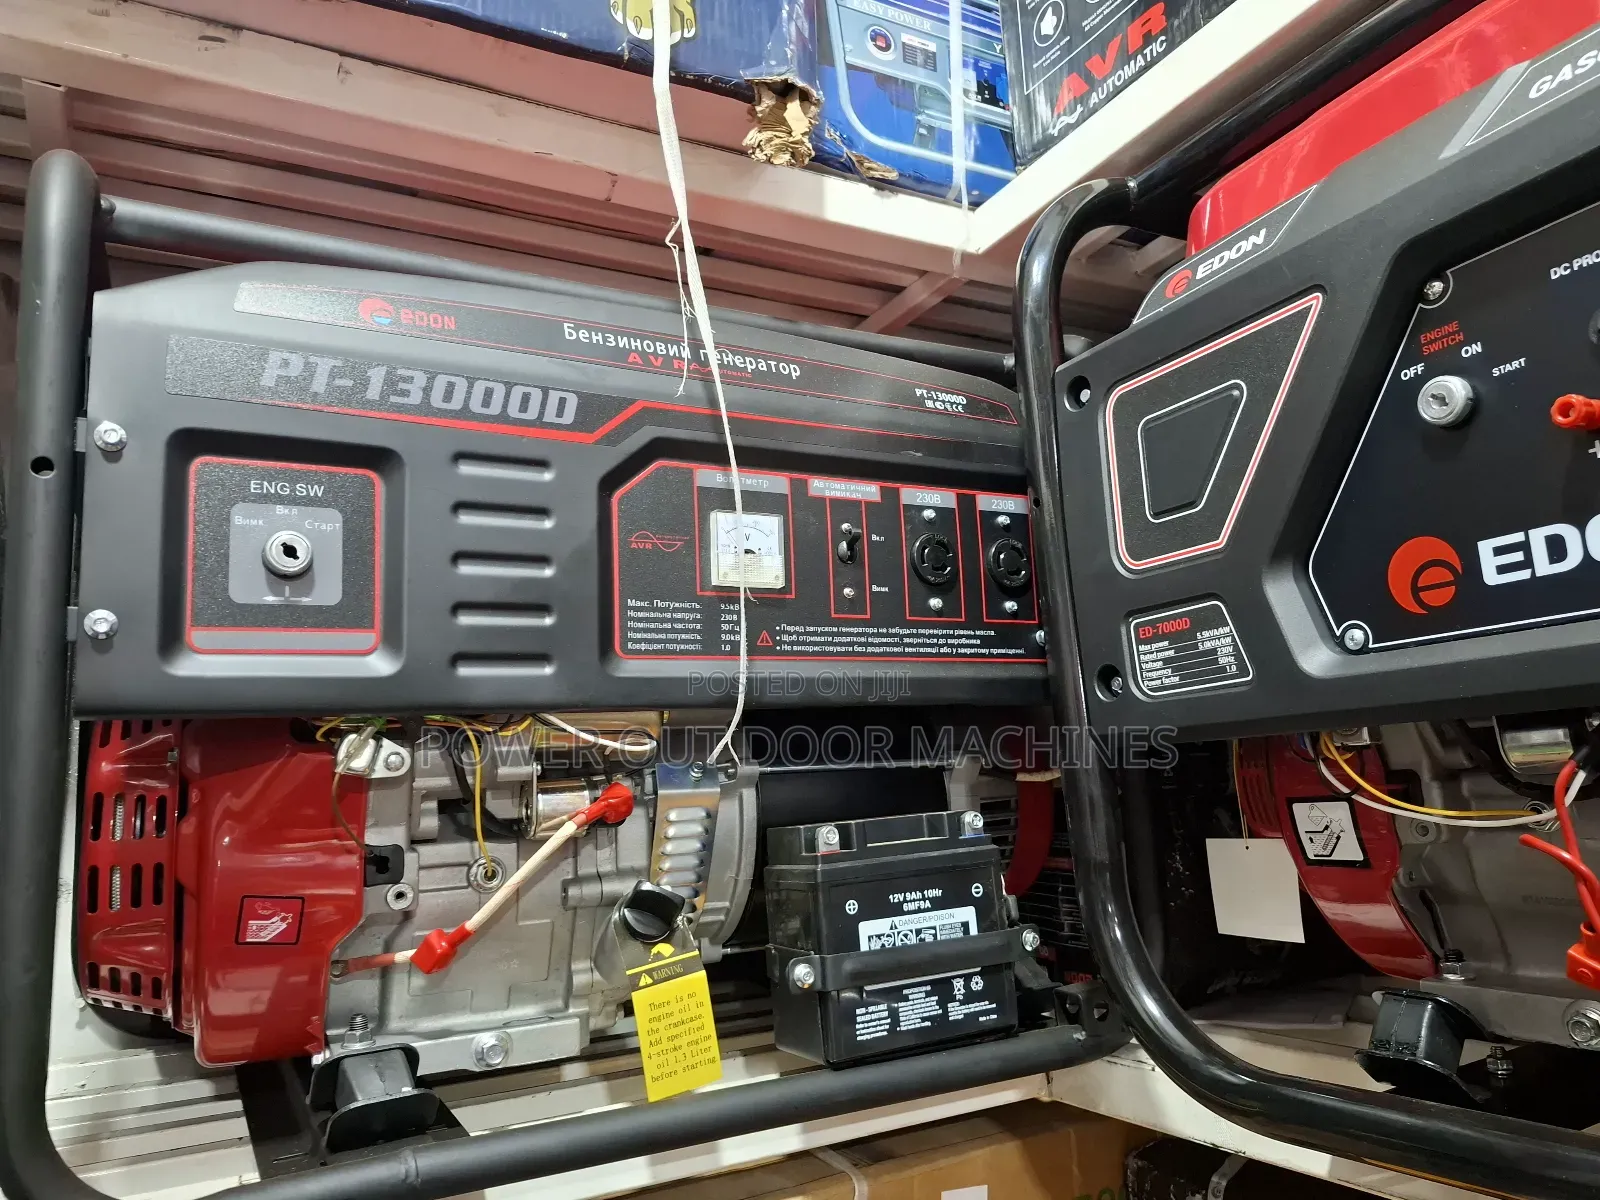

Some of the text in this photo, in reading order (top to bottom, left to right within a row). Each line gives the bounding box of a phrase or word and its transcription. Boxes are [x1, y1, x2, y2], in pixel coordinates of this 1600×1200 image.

[854, 0, 931, 31] EASY POWER
[1053, 2, 1167, 117] AVR
[1089, 36, 1166, 108] AUTOMATIC
[1529, 50, 1600, 98] GAS
[1196, 228, 1267, 280] EDON
[1550, 250, 1600, 280] DC PRO
[564, 322, 692, 360] Бензиновий
[1420, 320, 1460, 344] ENGINE
[1422, 332, 1464, 356] SWITCH
[1461, 342, 1482, 358] ON
[627, 351, 686, 372] AVR
[1492, 358, 1526, 376] START
[719, 369, 752, 378] UTOMATIC
[1400, 363, 1425, 381] OFF
[261, 350, 578, 425] PT-13000D
[914, 388, 966, 404] PT-13000D
[716, 474, 769, 488] Волтметр
[814, 480, 876, 492] Автоматичний
[826, 490, 862, 498] вимикач
[276, 506, 298, 516] Вкл
[234, 516, 264, 526] Вимк
[305, 520, 341, 532] Старт
[744, 532, 750, 542] V
[1477, 513, 1600, 586] ED
[654, 600, 703, 609] Потужність:
[628, 610, 671, 618] Номінальна
[672, 612, 703, 620] напруга:
[628, 620, 671, 628] Номінальна
[781, 624, 804, 632] Перед
[888, 627, 917, 635] забудьте
[1138, 618, 1191, 638] ED-7000D
[1152, 641, 1169, 650] power
[1140, 652, 1156, 661] Rated
[1157, 650, 1174, 659] power
[1141, 645, 1233, 670] Voltage 230V
[1143, 656, 1235, 678] Frequency 50Hz
[1162, 676, 1180, 684] factor
[1226, 664, 1236, 673] 1.0
[889, 888, 943, 903] 12V 9Ah 10Hr
[903, 900, 931, 911] 6MF9A
[899, 913, 955, 926] DANGER/POISON
[652, 964, 684, 980] WARNING
[648, 1000, 670, 1012] There
[688, 992, 696, 1000] no
[648, 1000, 704, 1024] engine oil in
[647, 1014, 705, 1037] the crankcase.
[648, 1024, 705, 1048] Add specified
[647, 1034, 712, 1060] 4-stroke engine
[656, 1046, 712, 1070] oil 1.3 Liter
[651, 1069, 678, 1083] before
